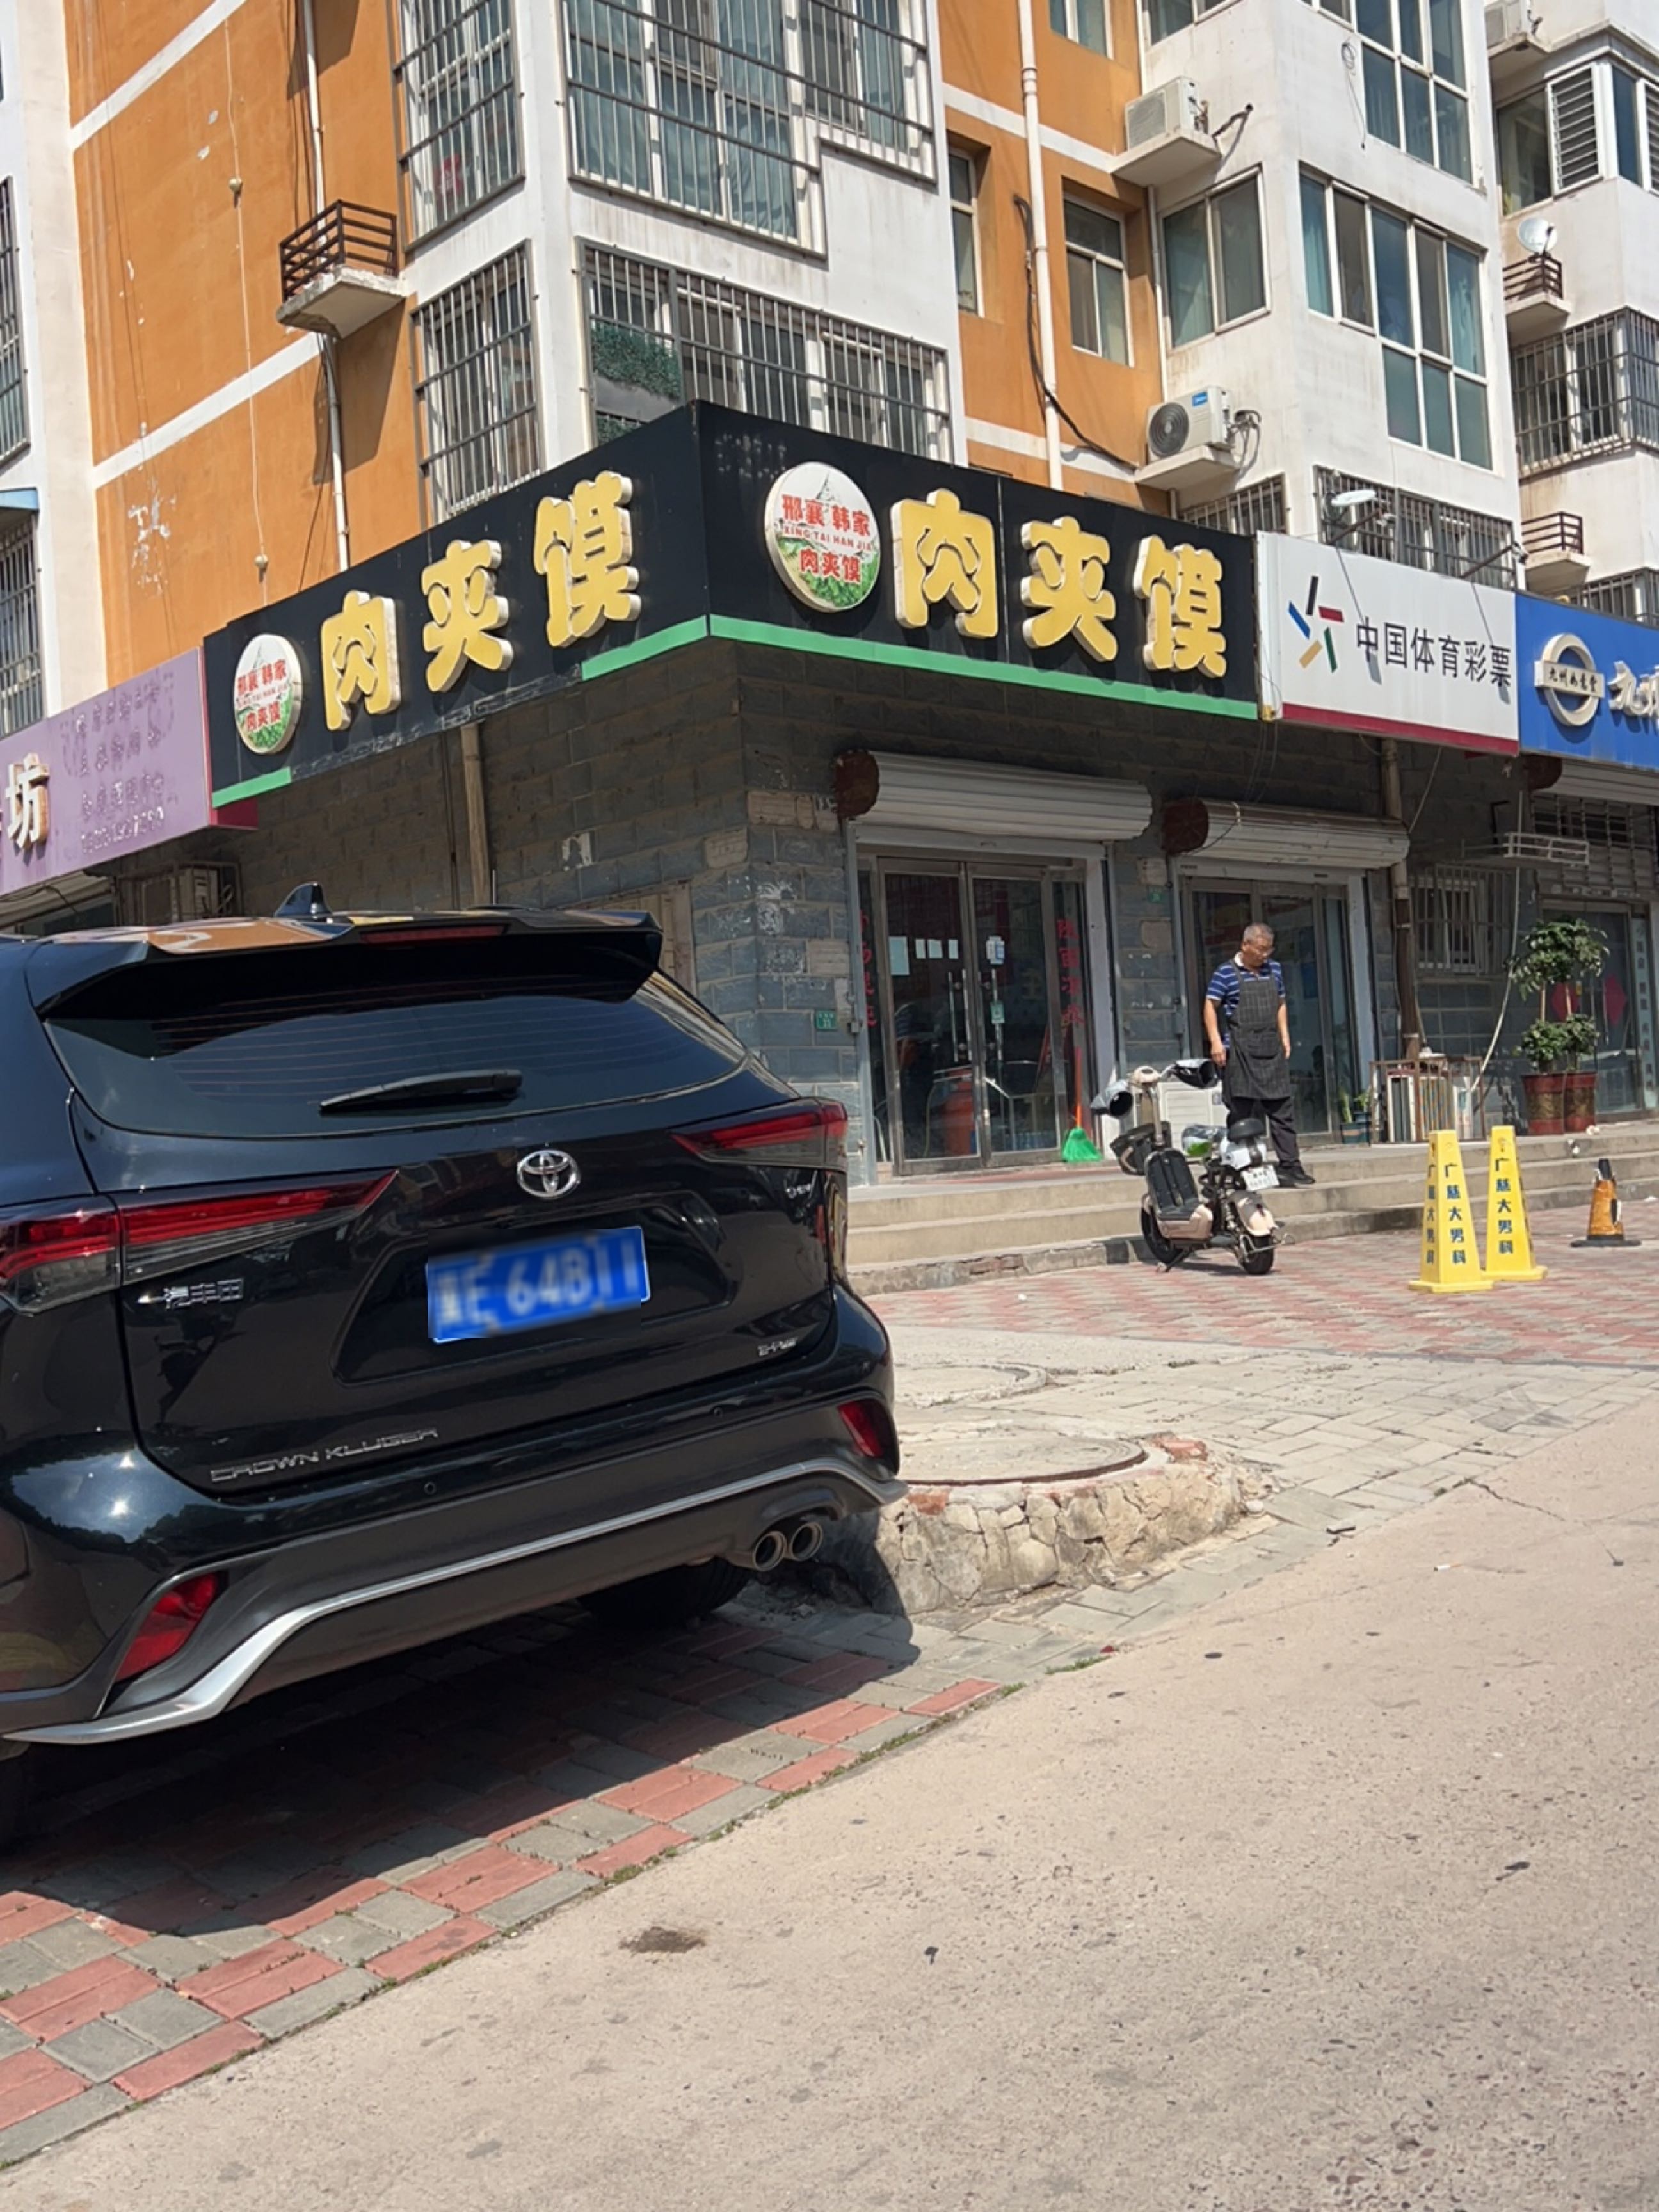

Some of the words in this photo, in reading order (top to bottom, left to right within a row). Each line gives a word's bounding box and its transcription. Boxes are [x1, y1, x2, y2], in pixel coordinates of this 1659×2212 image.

[321, 470, 641, 730] 肉夹馍
[800, 548, 861, 582] 肉夹馍
[891, 488, 1226, 678] 肉夹馍
[1356, 616, 1511, 687] 中国体育彩票
[0, 752, 50, 849] 坊
[211, 1451, 319, 1482] CROWN
